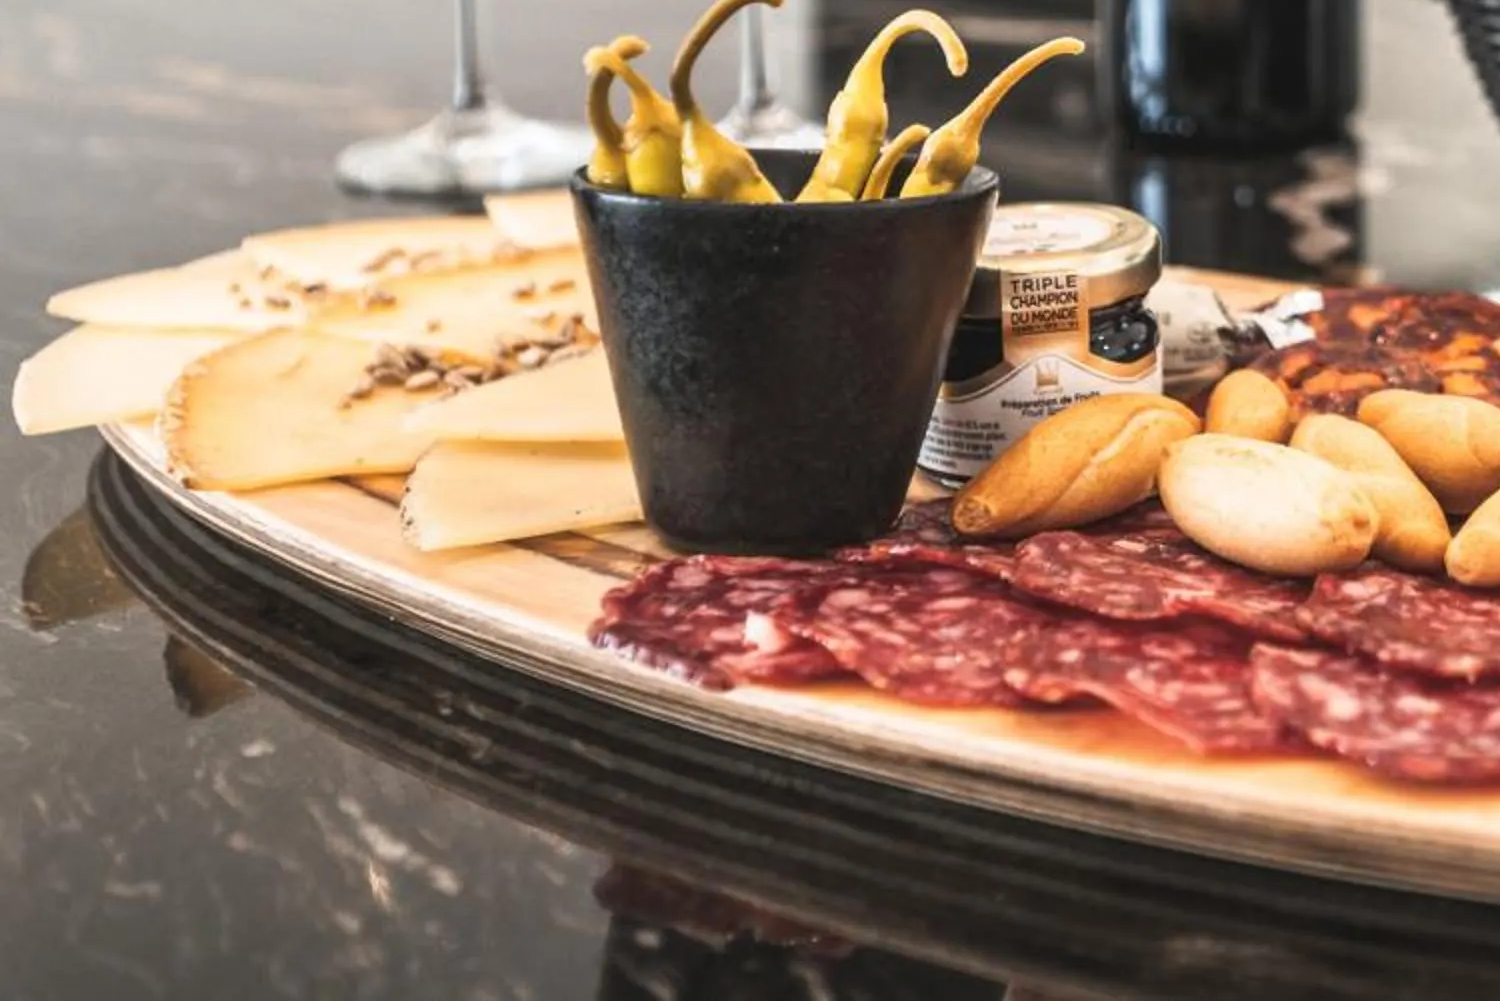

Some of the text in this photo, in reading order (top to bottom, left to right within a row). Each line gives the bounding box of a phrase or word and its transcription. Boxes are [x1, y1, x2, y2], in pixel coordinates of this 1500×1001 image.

[1010, 274, 1078, 294] TRIPLE
[1010, 291, 1079, 310] CHAMPION
[1011, 306, 1078, 326] DU MONDE
